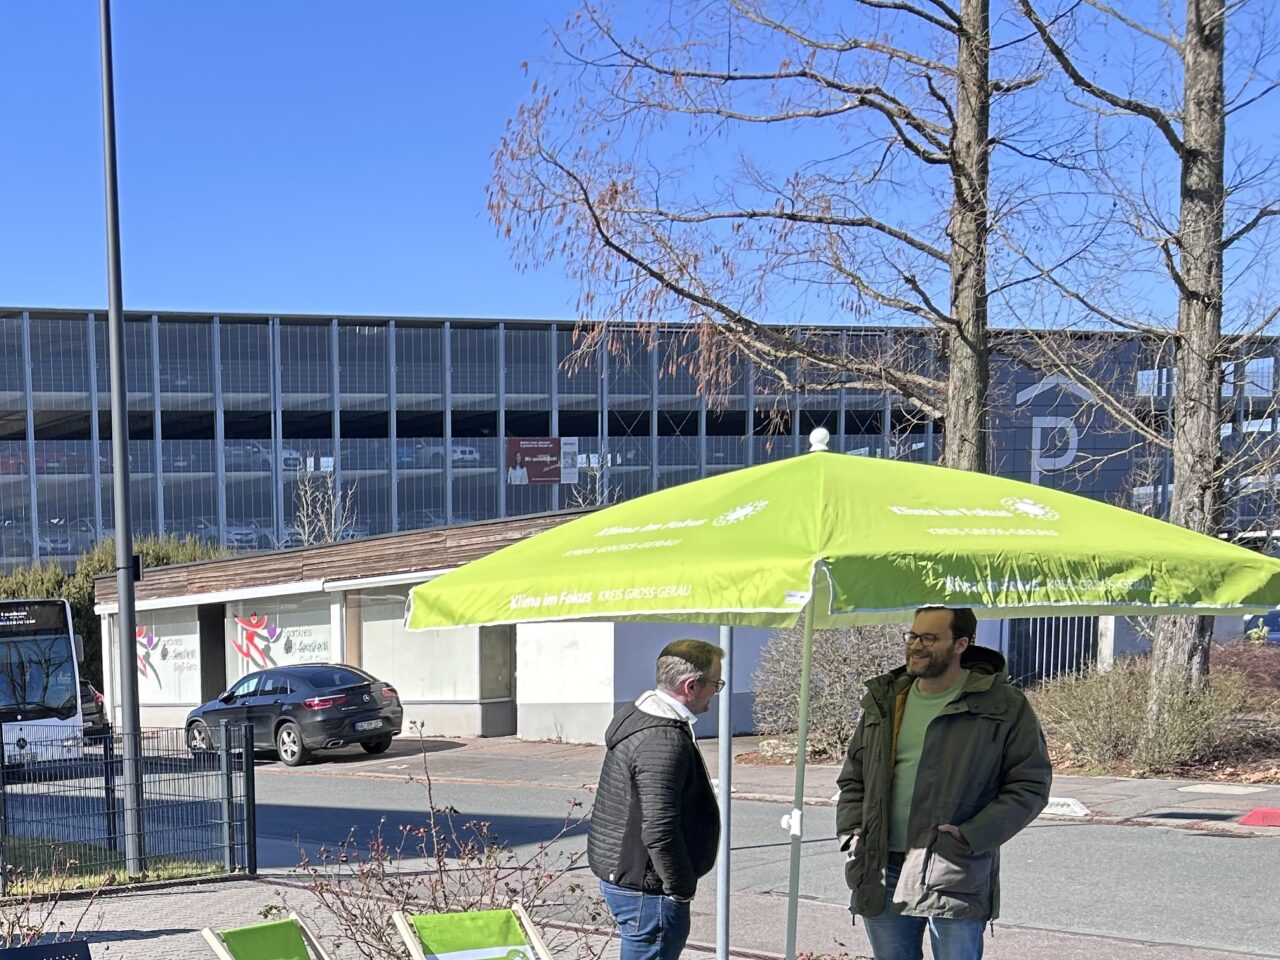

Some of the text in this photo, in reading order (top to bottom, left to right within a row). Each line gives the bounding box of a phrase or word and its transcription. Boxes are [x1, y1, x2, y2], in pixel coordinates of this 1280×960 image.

[1031, 416, 1078, 485] P
[510, 584, 692, 609] Klima im Fokus KREIS GROSS-GERAU
